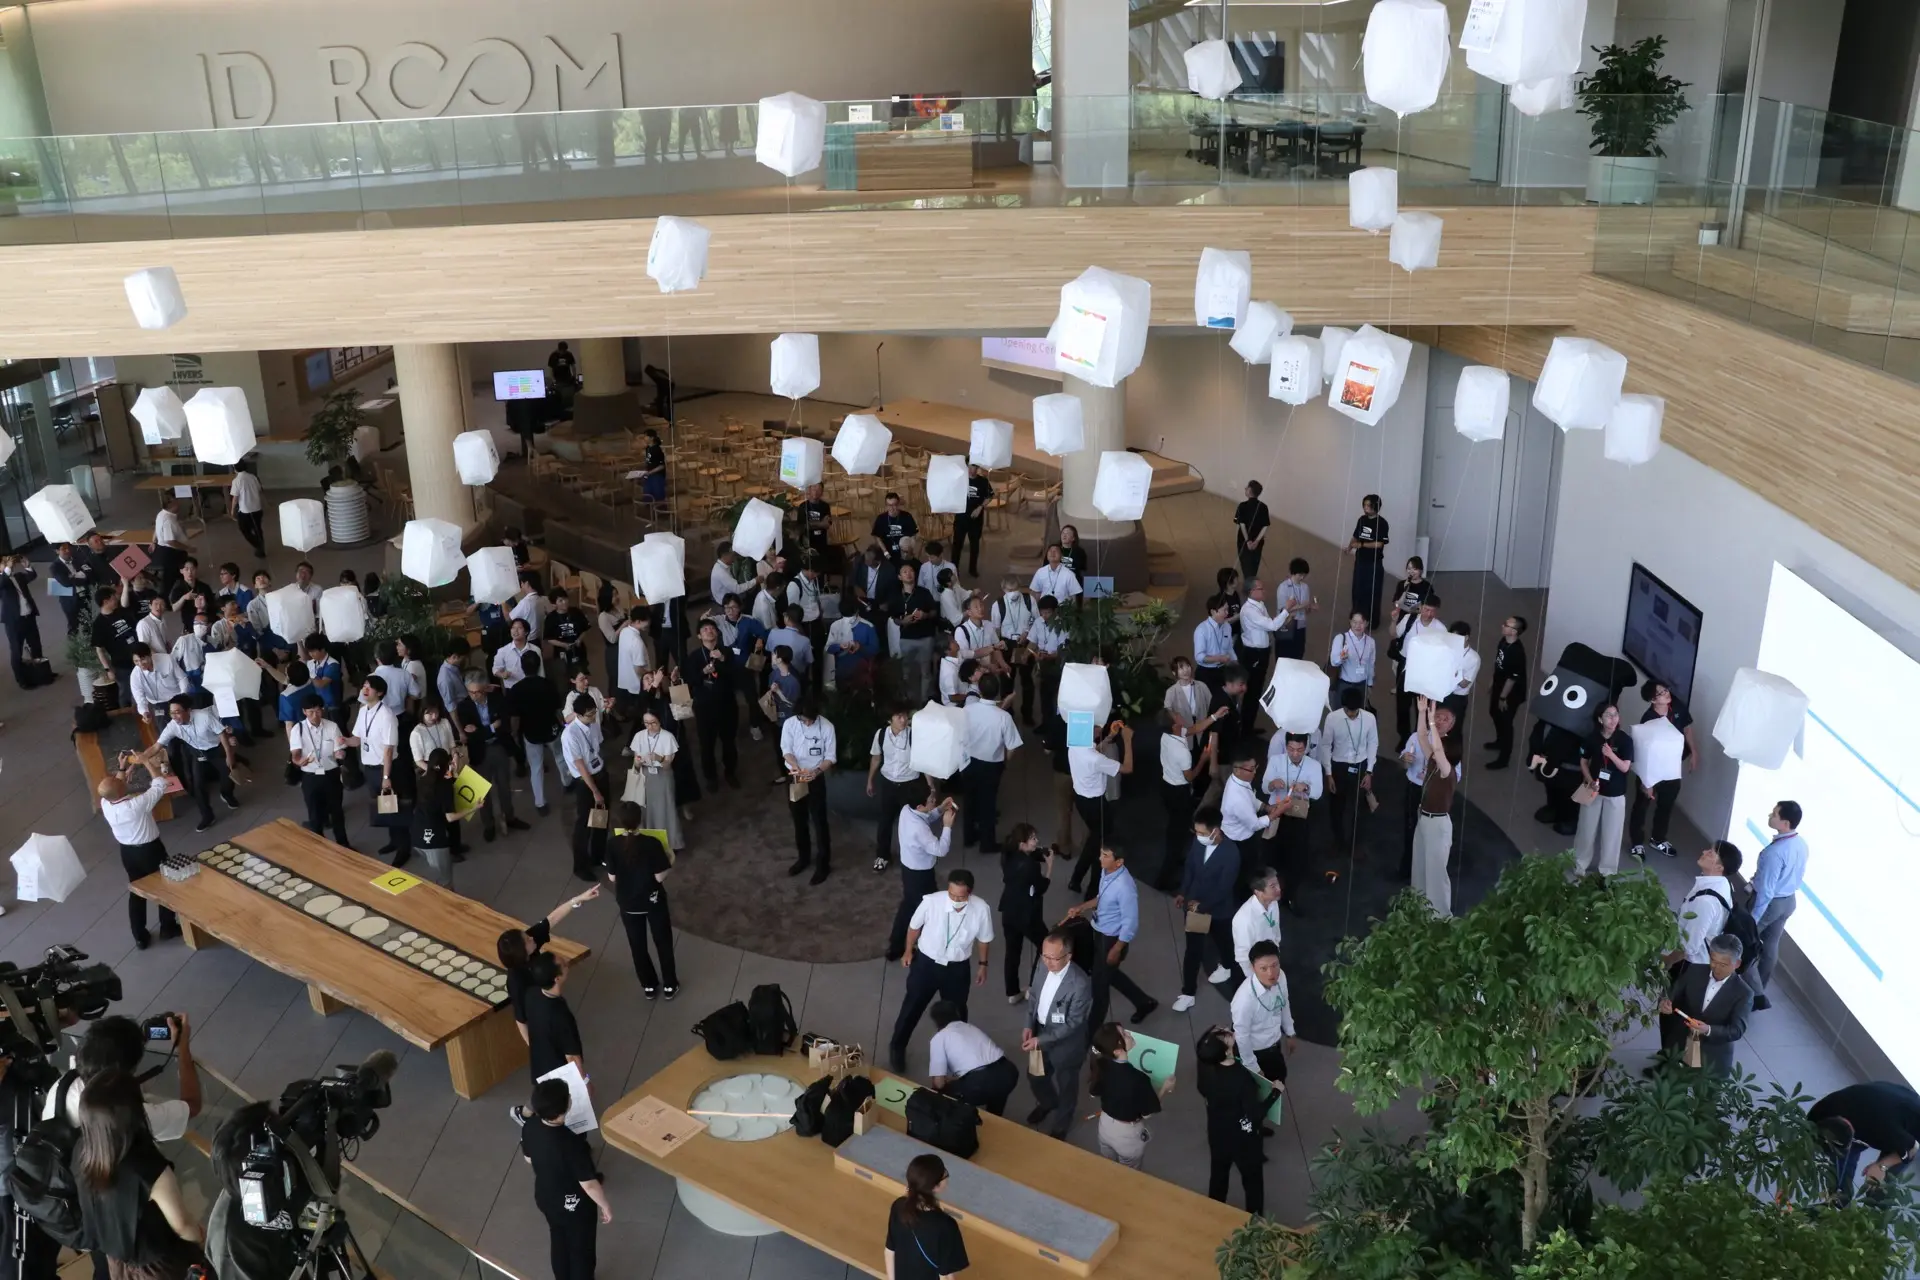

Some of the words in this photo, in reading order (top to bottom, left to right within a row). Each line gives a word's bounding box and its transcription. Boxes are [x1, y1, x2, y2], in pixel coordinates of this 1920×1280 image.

[196, 50, 277, 130] ID
[1002, 338, 1037, 354] Opening
[1039, 343, 1056, 354] Cer
[123, 556, 137, 569] B
[1093, 581, 1104, 592] A
[458, 785, 475, 803] D
[388, 877, 407, 887] D
[1139, 1048, 1157, 1074] C
